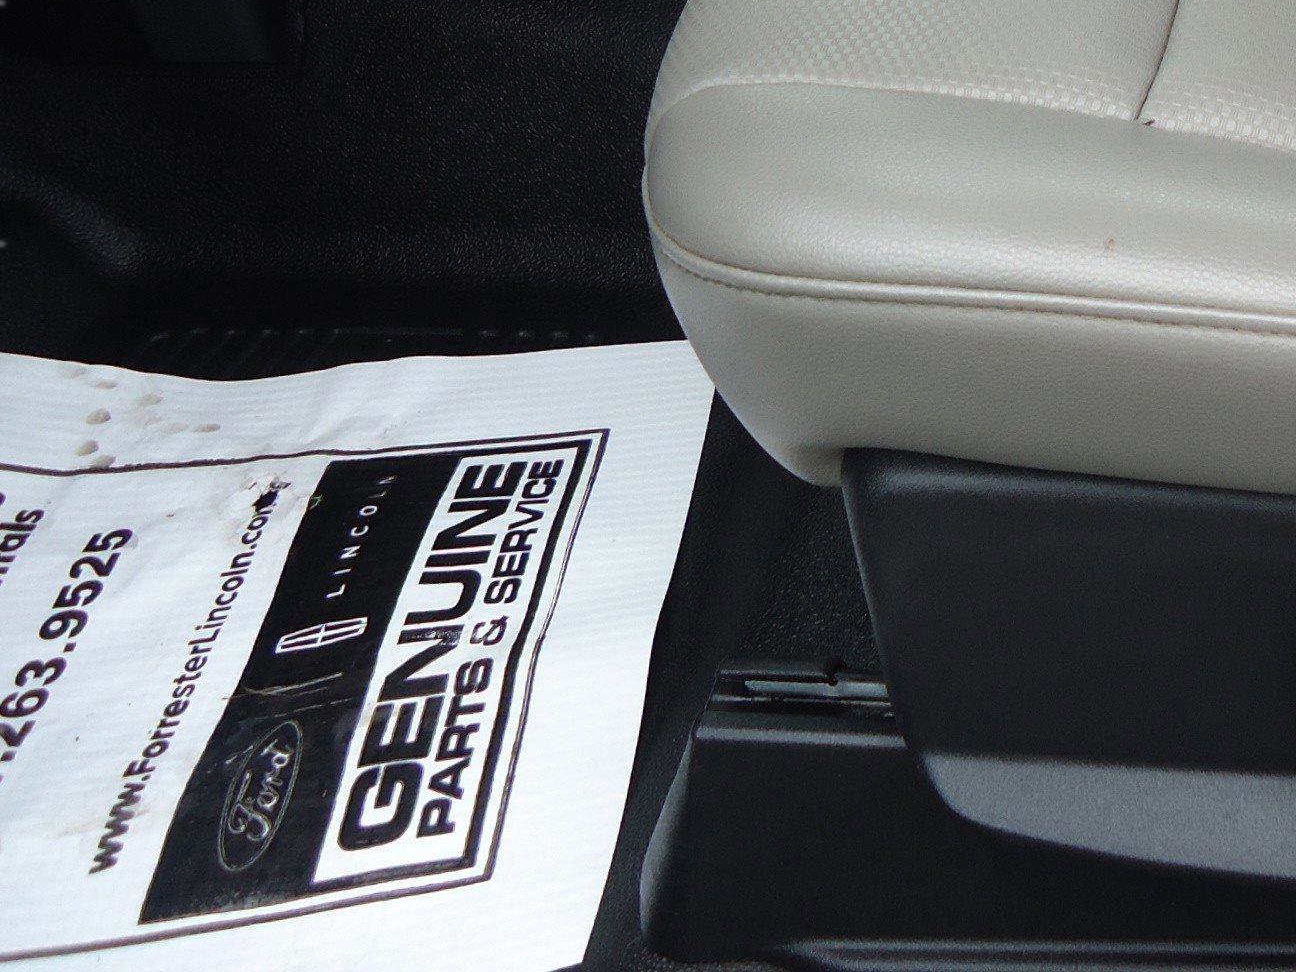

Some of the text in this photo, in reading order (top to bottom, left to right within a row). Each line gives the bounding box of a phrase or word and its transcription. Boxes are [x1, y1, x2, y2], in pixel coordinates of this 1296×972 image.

[228, 738, 292, 842] Ford
[337, 461, 528, 851] GENUINE
[416, 459, 565, 838] PARTS & SERVICE
